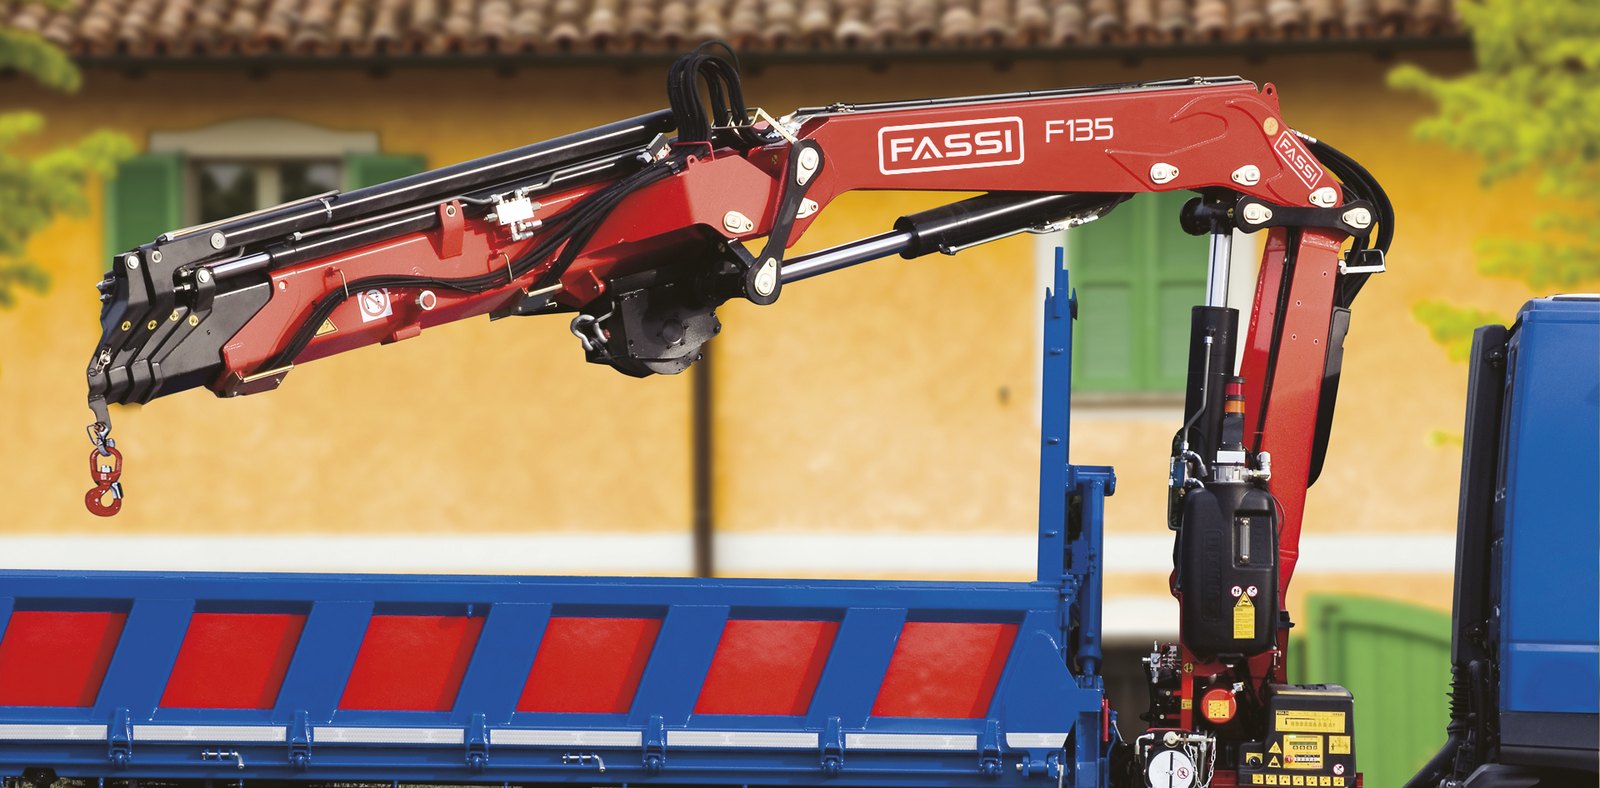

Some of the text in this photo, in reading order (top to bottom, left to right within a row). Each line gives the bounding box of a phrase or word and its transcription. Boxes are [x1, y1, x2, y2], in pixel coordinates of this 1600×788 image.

[890, 129, 1013, 162] FASSI
[1045, 117, 1114, 143] F135
[1279, 137, 1318, 183] FASSI
